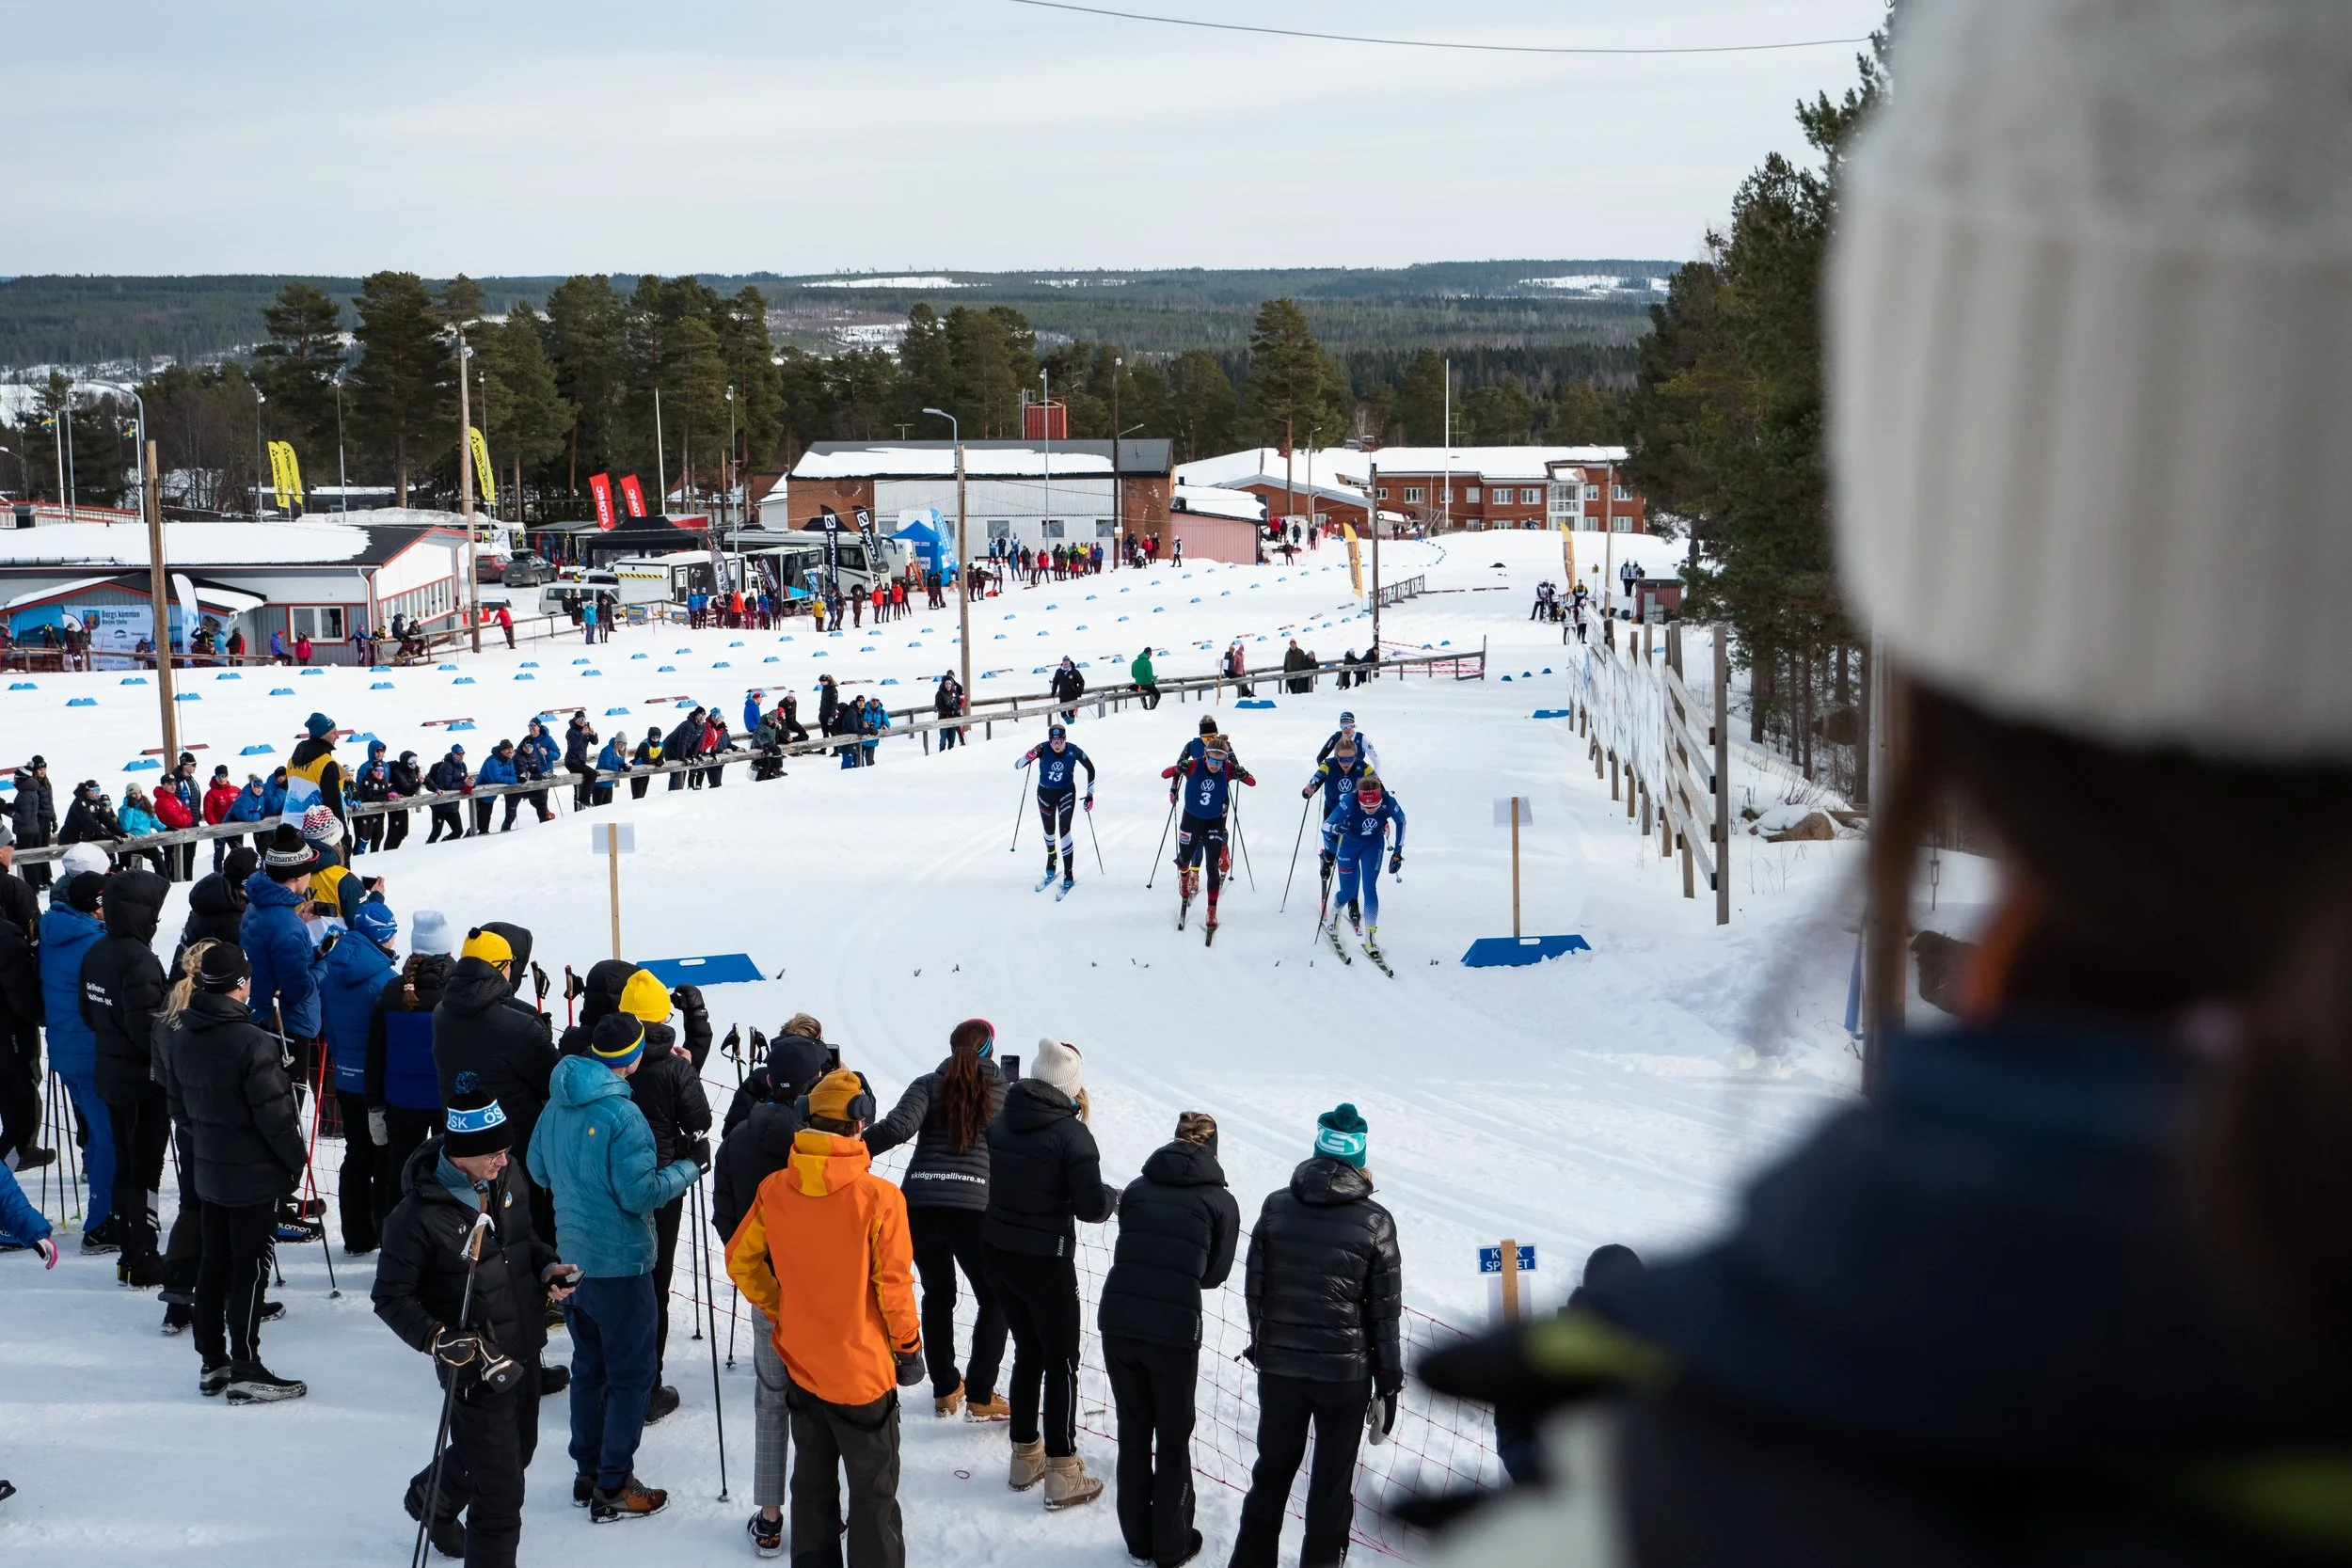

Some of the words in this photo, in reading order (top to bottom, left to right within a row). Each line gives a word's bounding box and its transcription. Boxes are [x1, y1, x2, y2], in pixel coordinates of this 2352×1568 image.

[102, 610, 118, 619] Bergs
[1200, 792, 1211, 806] 3
[911, 1171, 985, 1184] skidgymgallivare.se
[1491, 1248, 1522, 1259] KK
[1486, 1259, 1529, 1272] SPET
[248, 1385, 295, 1393] FISCHER
